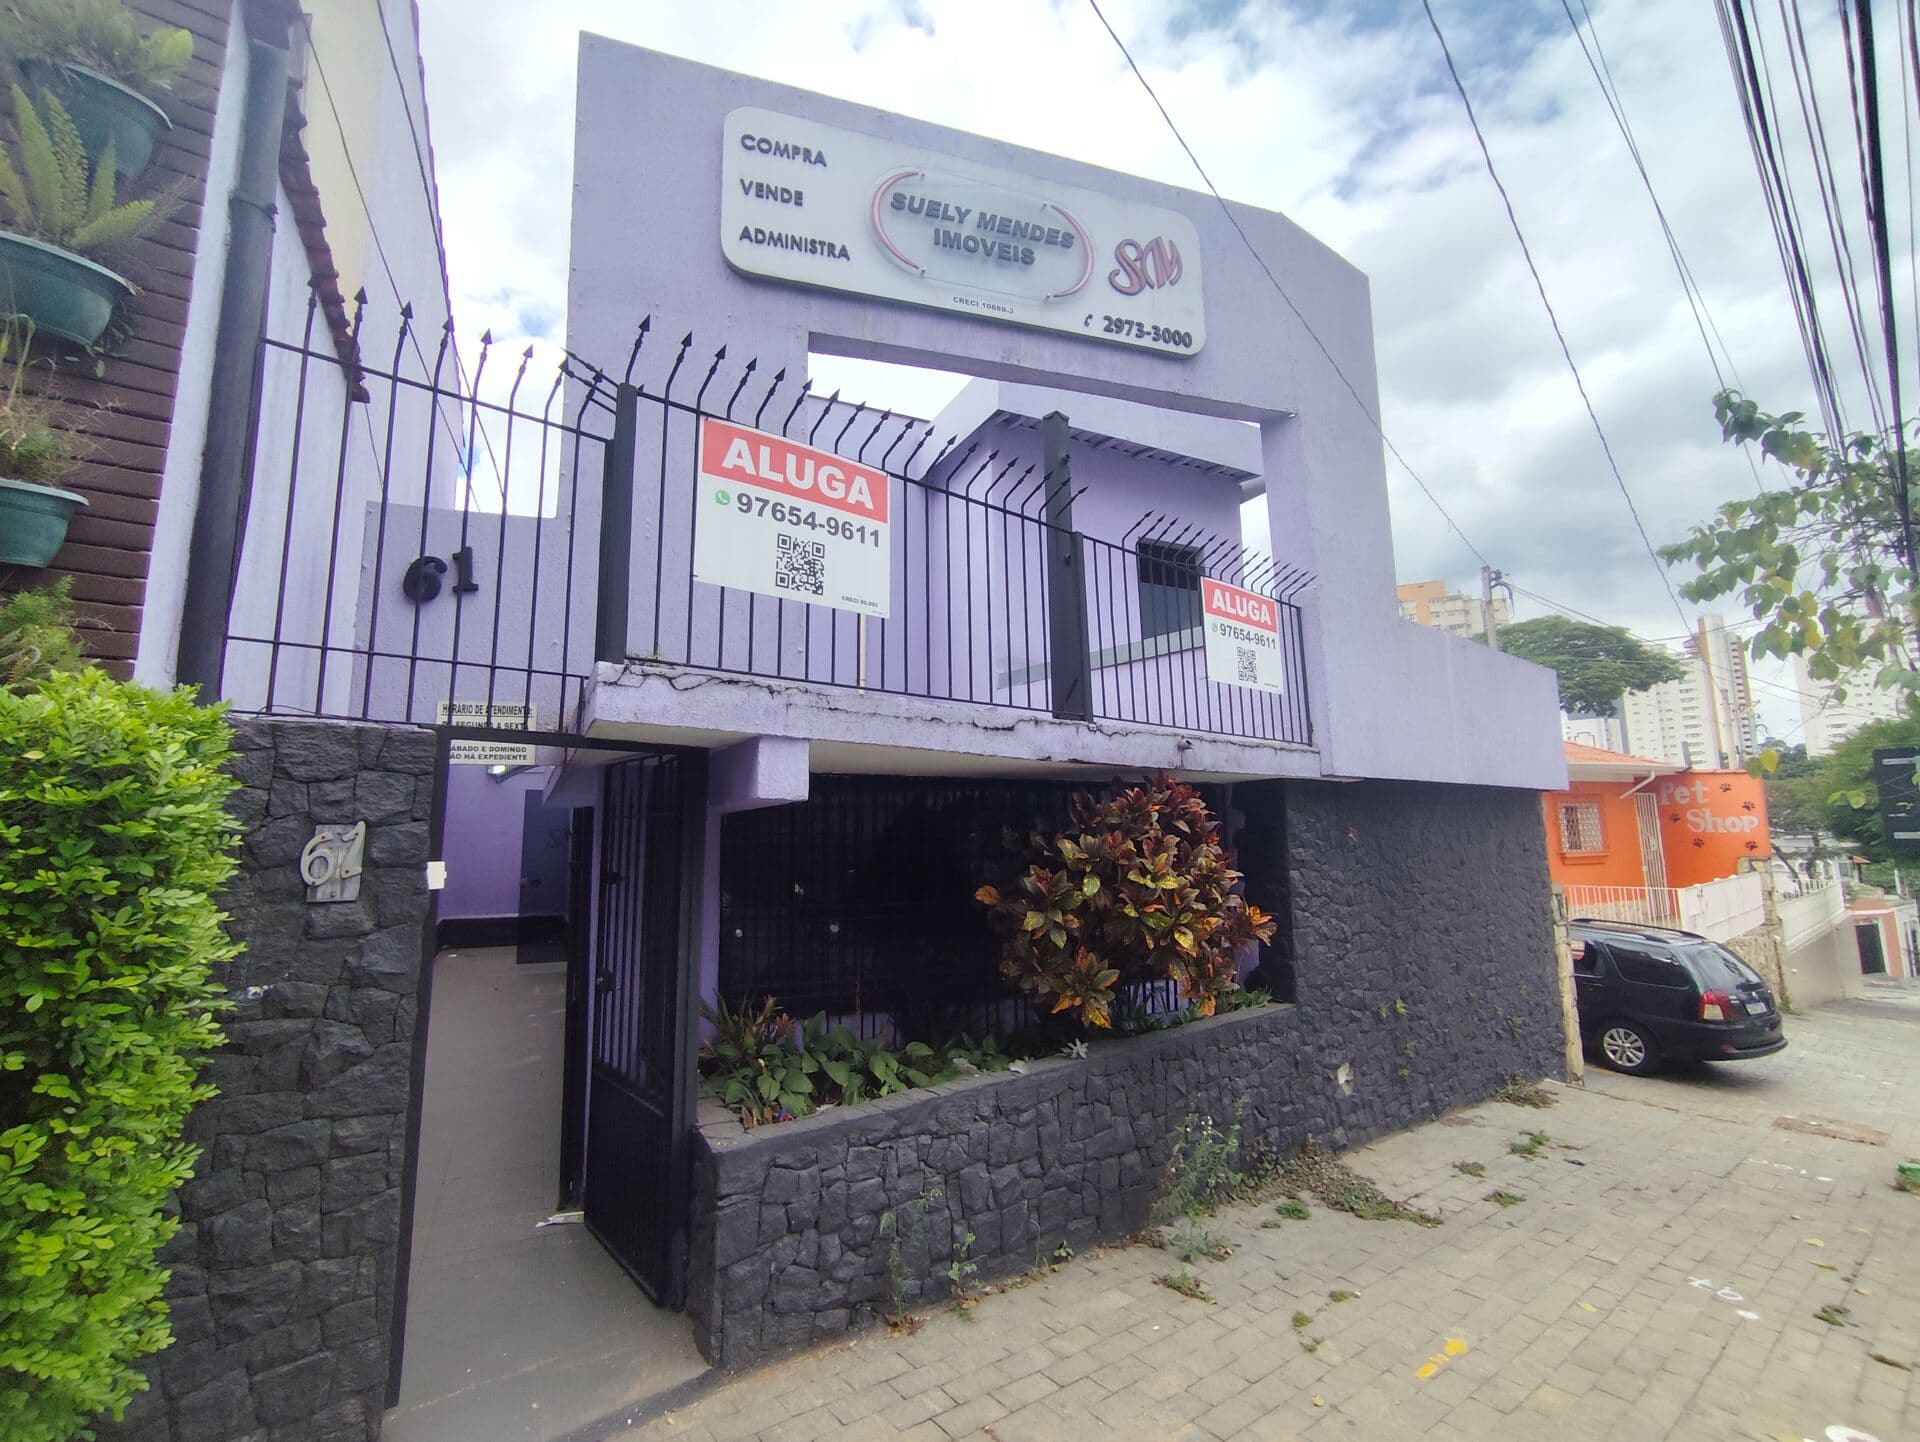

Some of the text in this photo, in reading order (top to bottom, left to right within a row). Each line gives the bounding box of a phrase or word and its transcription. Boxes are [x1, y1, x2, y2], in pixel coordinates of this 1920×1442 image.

[740, 134, 828, 168] COMPRA
[740, 179, 804, 207] VENDE
[891, 192, 1075, 249] SUELY MENDES
[739, 226, 851, 261] ADMINISTRA
[934, 228, 1036, 266] IMOVEIS
[953, 296, 979, 307] CRECI
[1103, 315, 1193, 349] 2973-3000
[722, 437, 874, 510] ALUGA
[737, 492, 880, 548] 97654-9611
[404, 547, 479, 605] 61
[1212, 588, 1272, 626] ALUGA
[1220, 623, 1276, 650] 97654-9611
[442, 702, 473, 715] HRÁRIO
[475, 705, 483, 715] DE
[450, 745, 479, 753] ÁBADO
[478, 753, 528, 761] EXPEDIENTE
[1661, 780, 1710, 806] Pet
[1686, 808, 1760, 833] Shop
